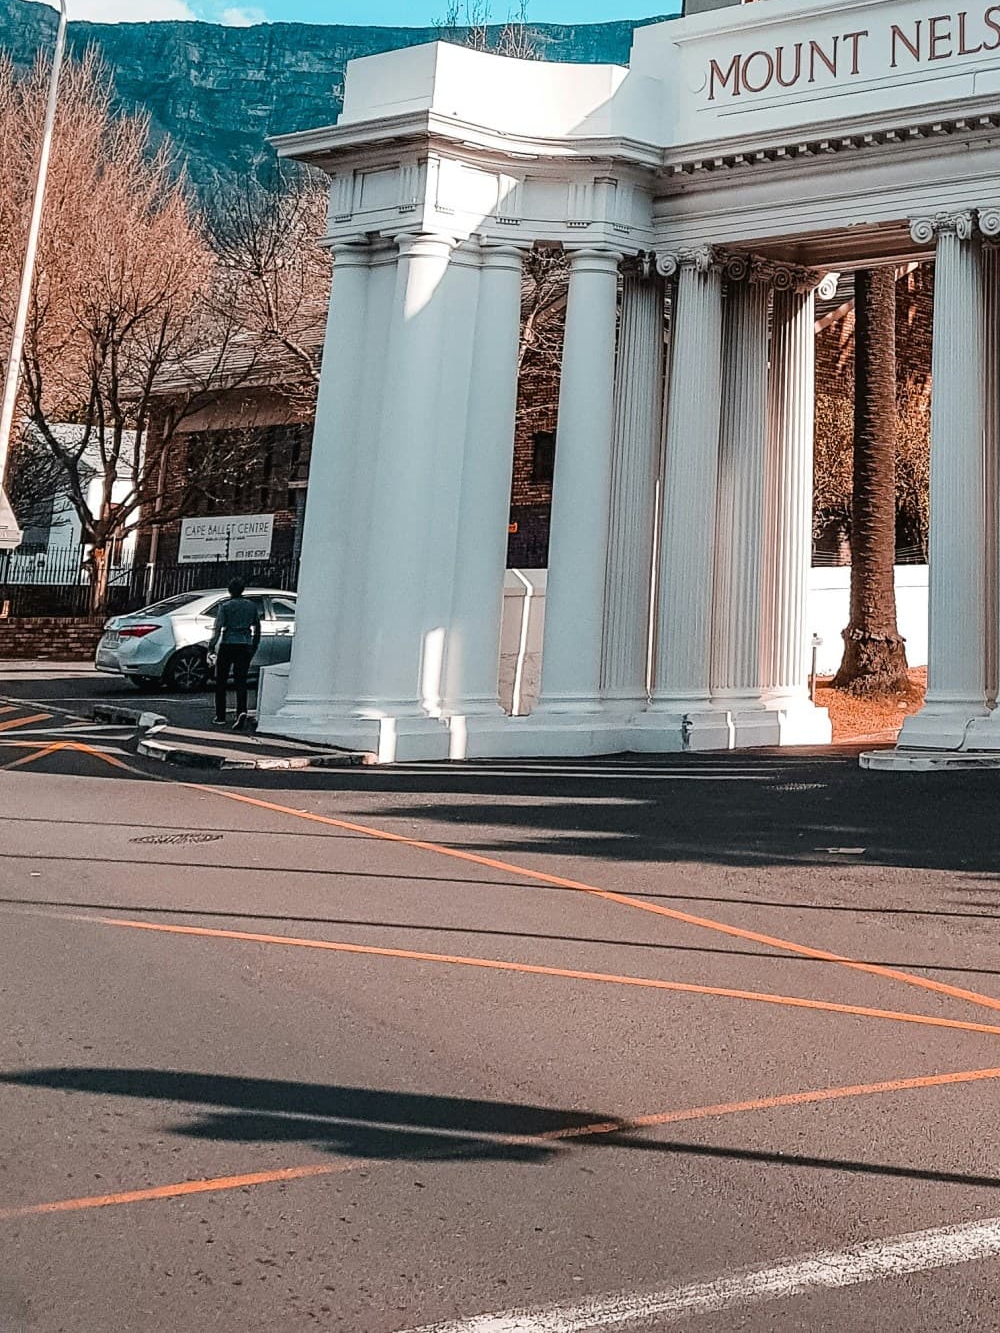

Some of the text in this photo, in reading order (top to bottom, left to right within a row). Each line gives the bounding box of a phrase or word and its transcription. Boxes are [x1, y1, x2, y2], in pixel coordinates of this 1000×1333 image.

[708, 30, 868, 101] MOUNT
[185, 522, 269, 536] CAPE BALLET CENTRE
